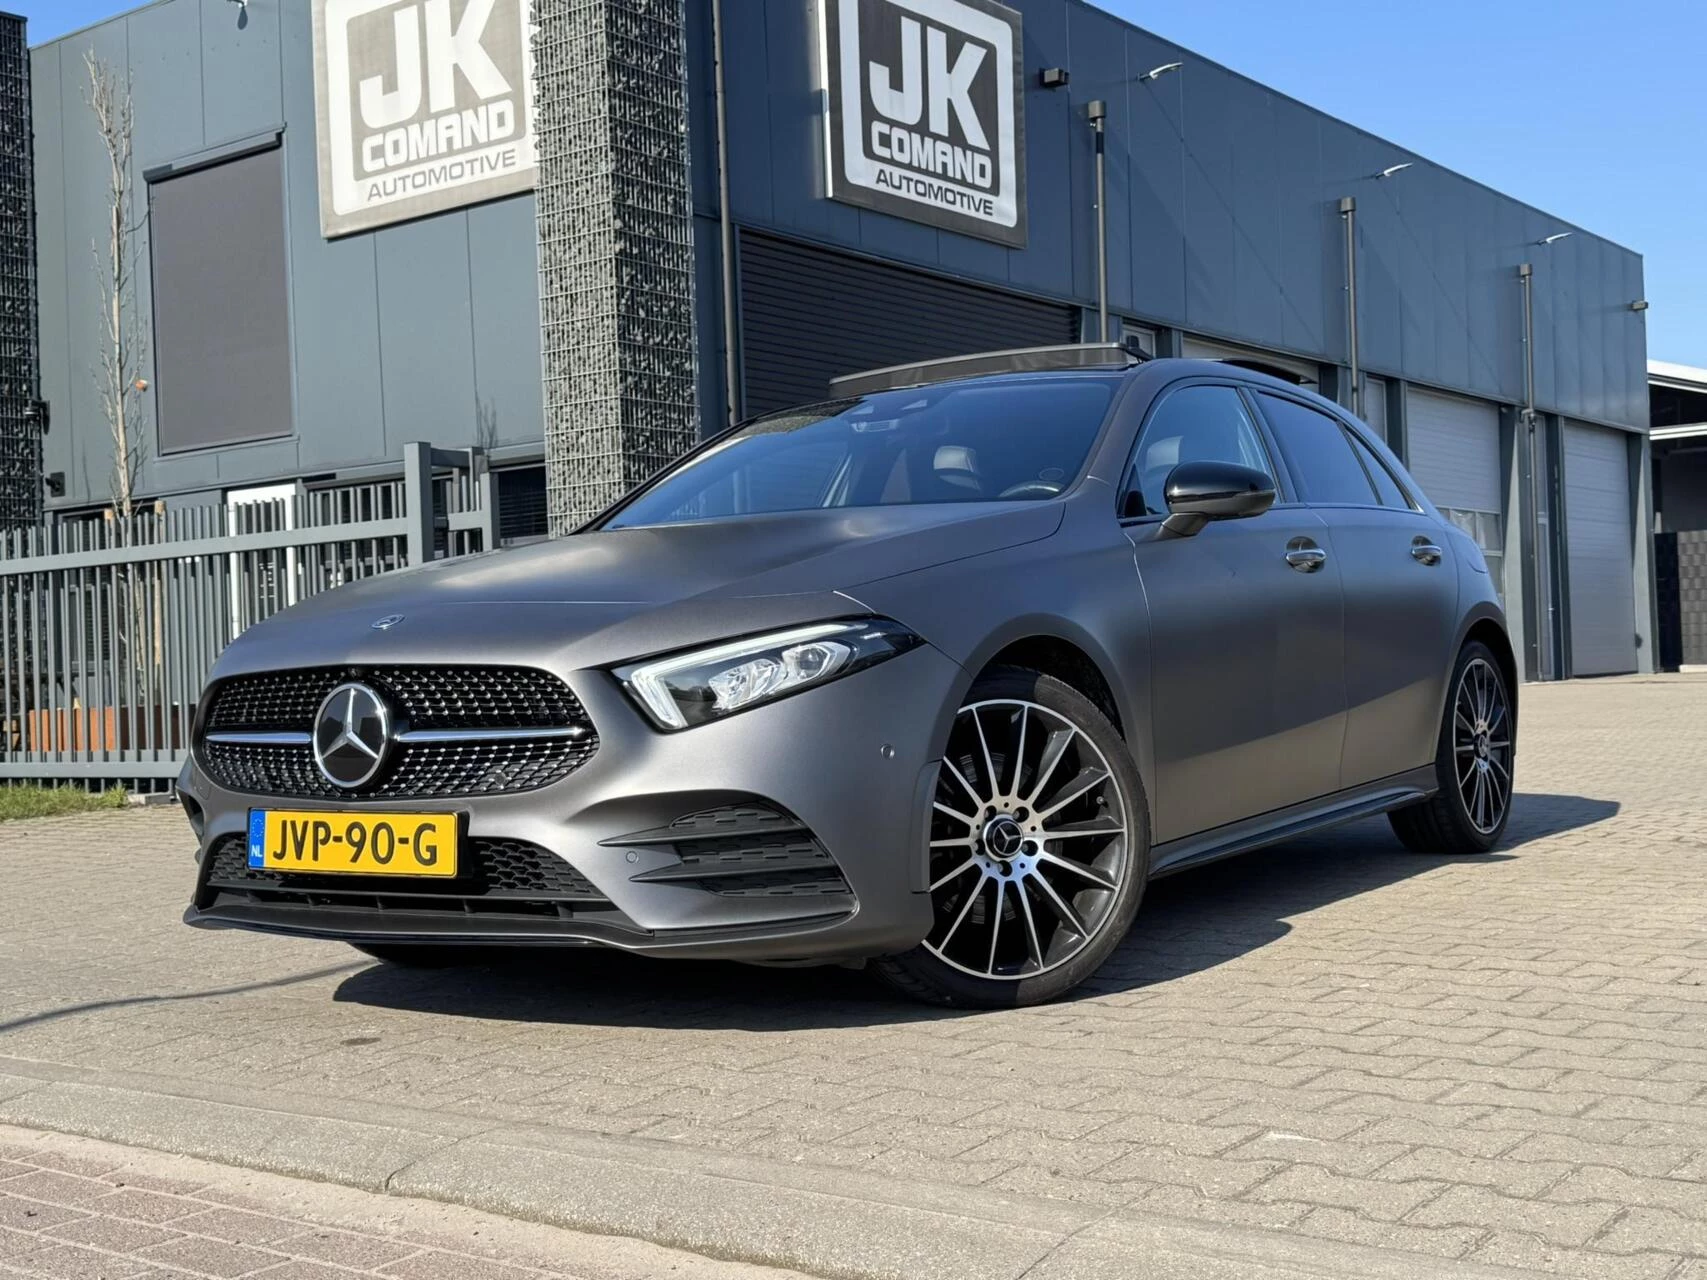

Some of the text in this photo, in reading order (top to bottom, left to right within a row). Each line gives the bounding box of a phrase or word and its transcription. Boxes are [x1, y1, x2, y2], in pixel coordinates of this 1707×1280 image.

[359, 0, 512, 129] JK
[869, 16, 991, 151] JK
[362, 99, 515, 173] COMAND
[871, 120, 992, 189] COMAND
[367, 149, 516, 201] AUTOMOTIVE
[875, 169, 994, 216] AUTOMOTIVE
[251, 845, 263, 858] NL
[272, 820, 437, 866] JVP-90-G
